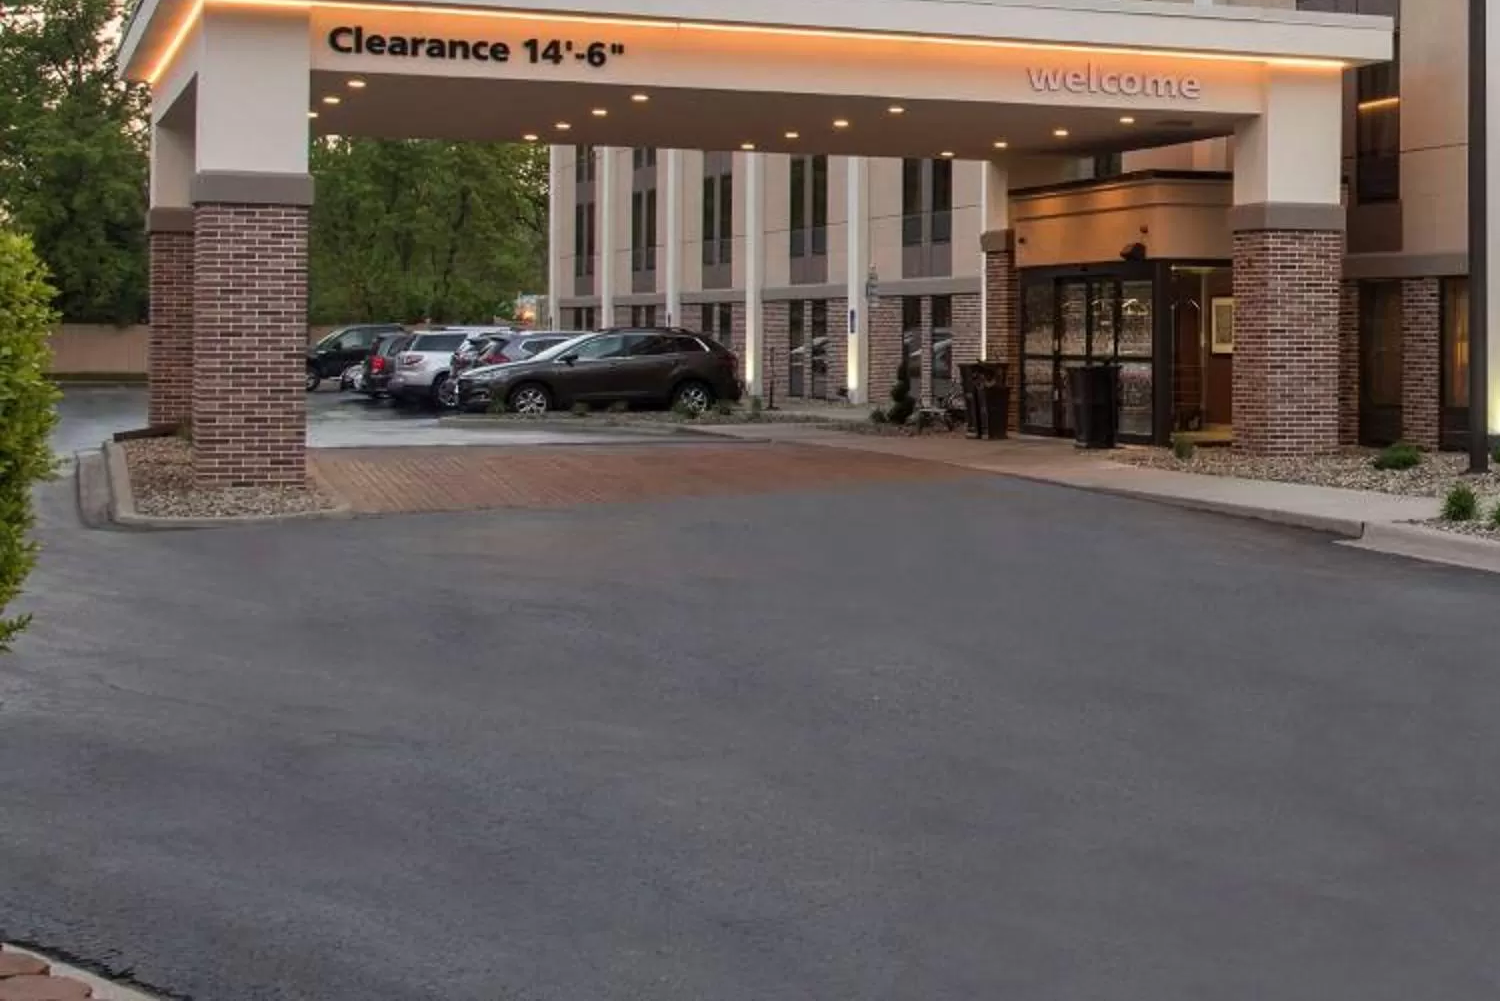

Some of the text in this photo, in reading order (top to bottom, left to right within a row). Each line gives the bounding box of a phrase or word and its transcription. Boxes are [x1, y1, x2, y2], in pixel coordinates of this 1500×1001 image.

[327, 26, 625, 68] Clearance 14'-6"
[1026, 59, 1201, 99] welcome
